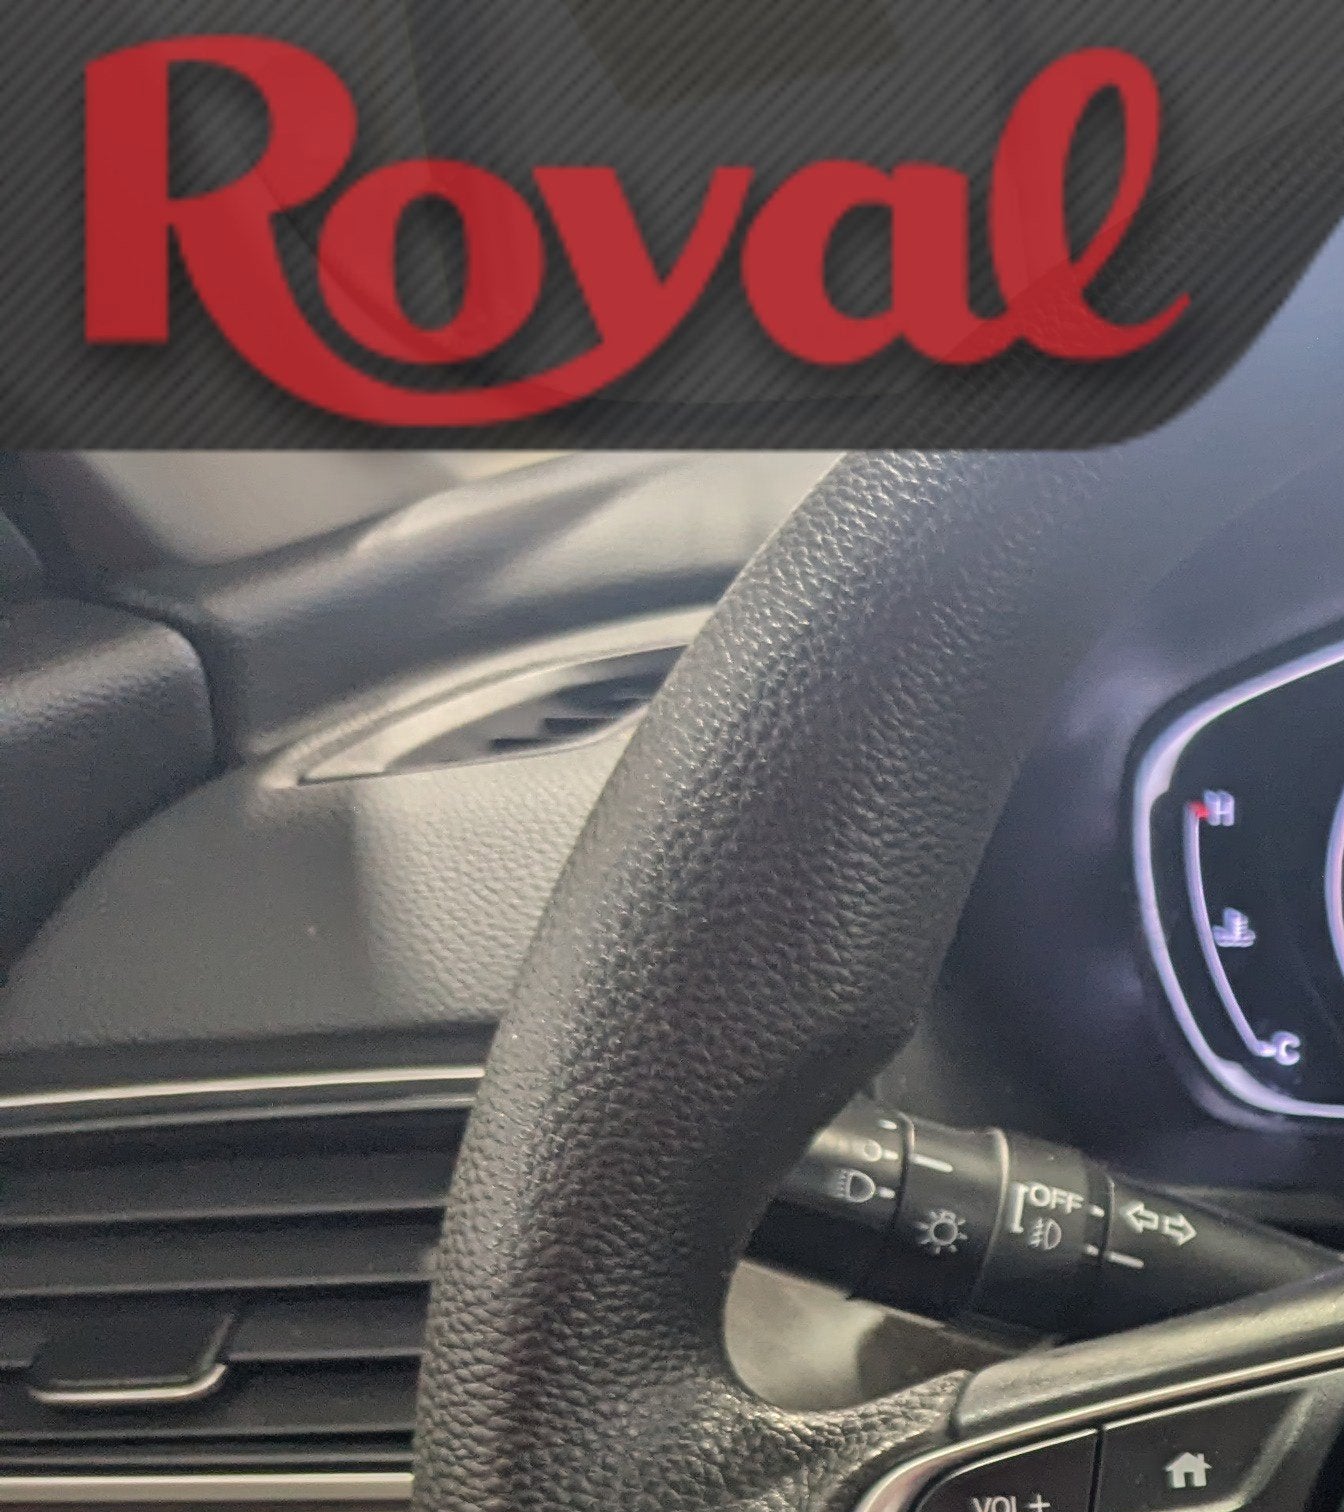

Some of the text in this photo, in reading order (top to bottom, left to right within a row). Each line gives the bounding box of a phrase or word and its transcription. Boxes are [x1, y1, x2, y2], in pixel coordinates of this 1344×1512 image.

[1203, 789, 1235, 826] H
[1271, 1031, 1300, 1065] C
[1029, 1183, 1083, 1214] OFF
